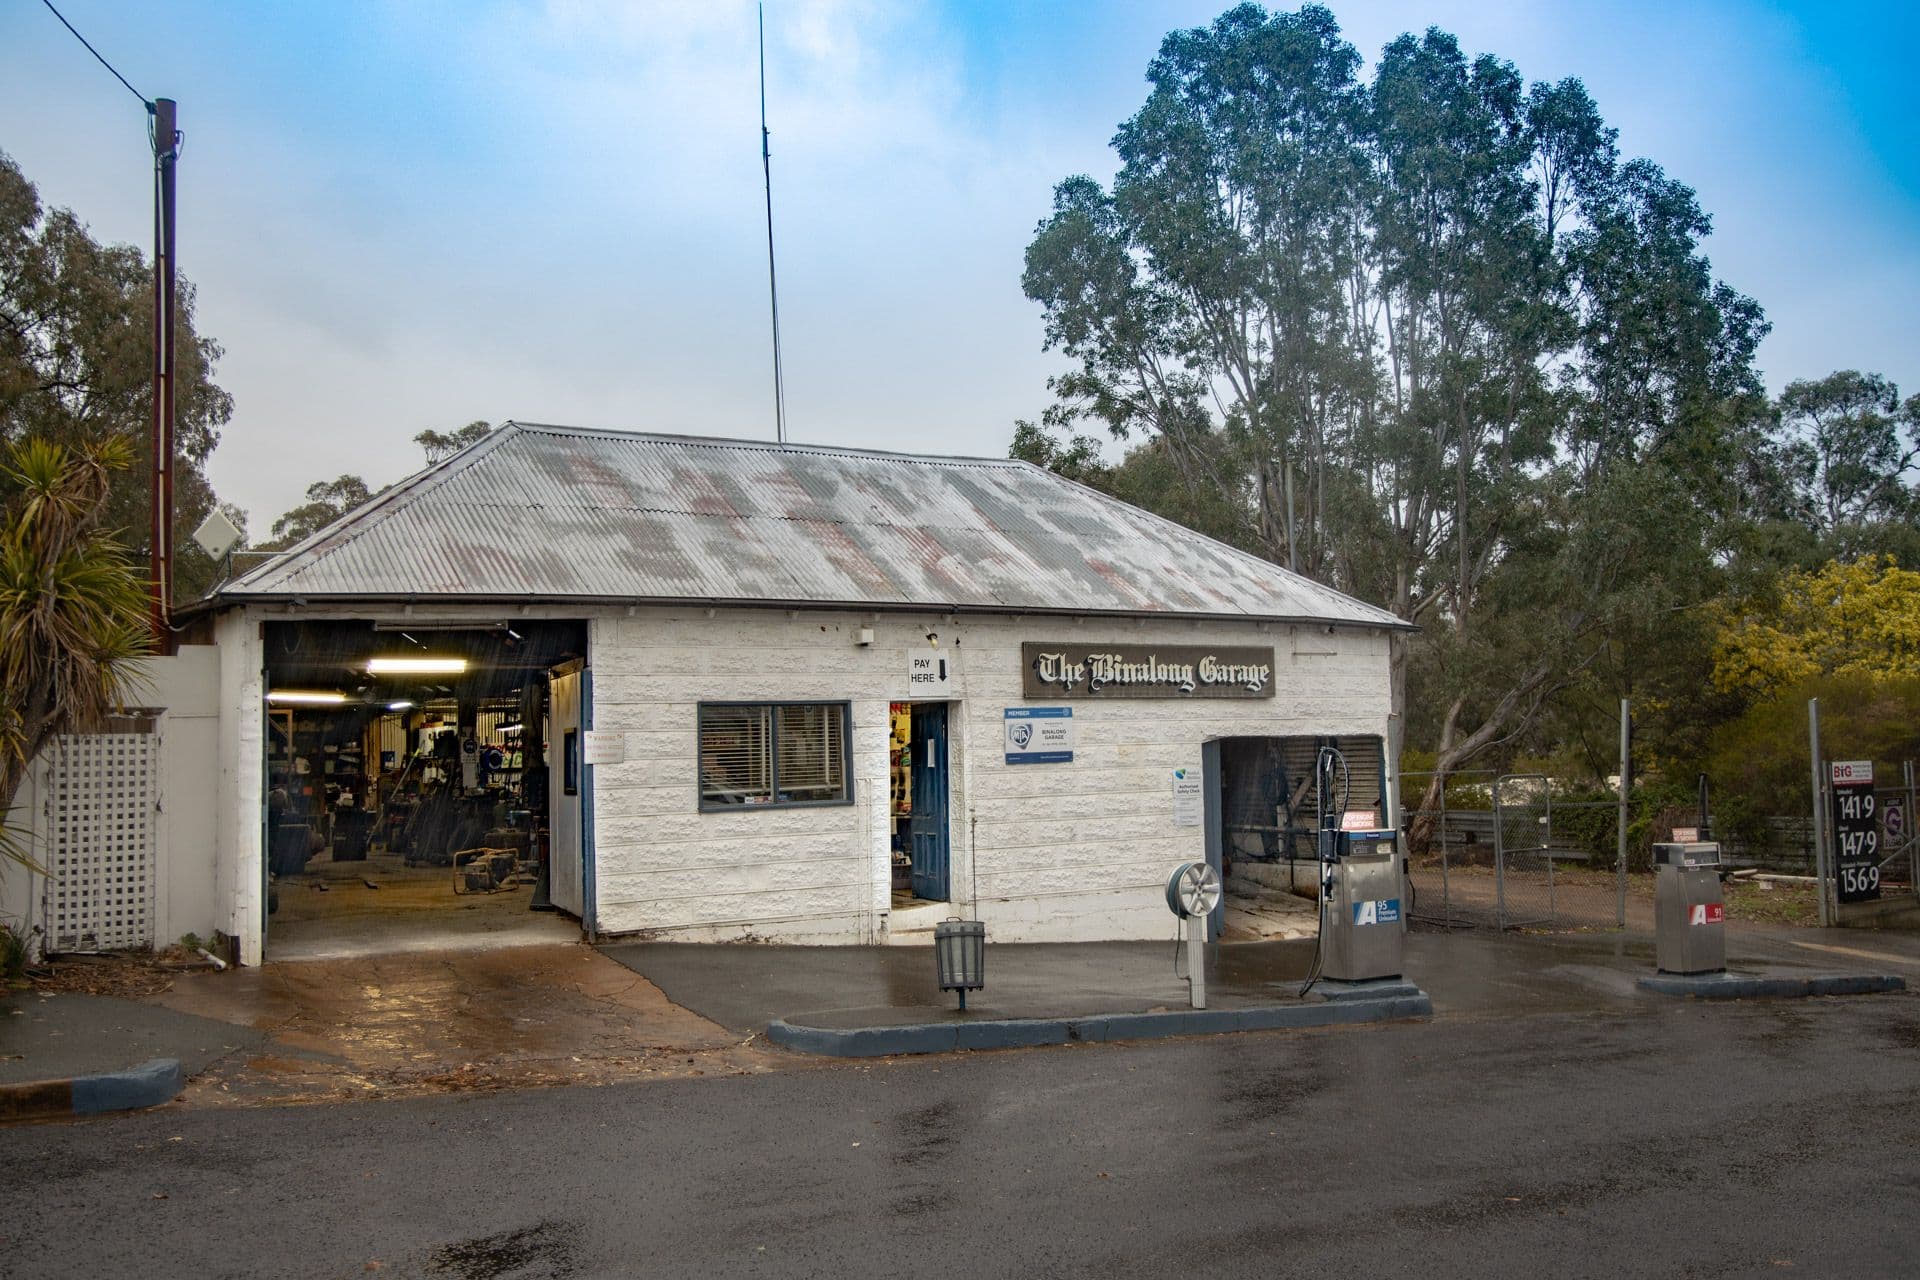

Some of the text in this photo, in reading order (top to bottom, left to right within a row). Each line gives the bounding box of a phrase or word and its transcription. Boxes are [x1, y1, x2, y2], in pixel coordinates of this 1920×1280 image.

[914, 659, 930, 668] PAY
[1036, 653, 1271, 692] The Binalong Garage
[911, 674, 935, 682] HERE
[1377, 901, 1388, 911] 95
[1378, 909, 1397, 917] Premium
[1714, 907, 1722, 918] 91
[1378, 914, 1398, 922] Unleaded
